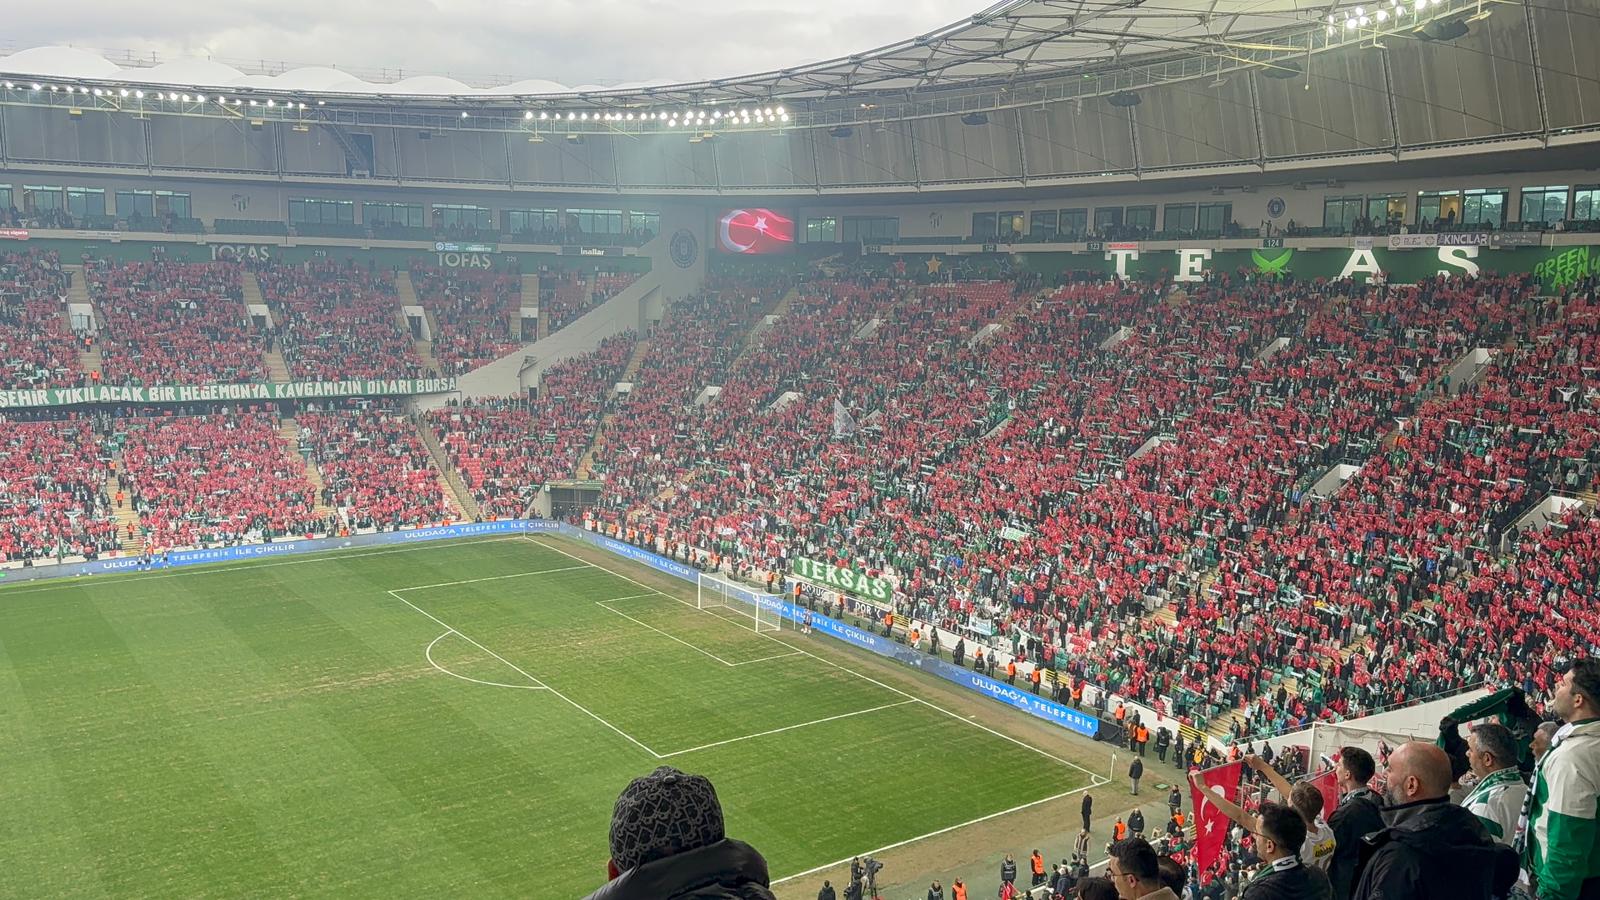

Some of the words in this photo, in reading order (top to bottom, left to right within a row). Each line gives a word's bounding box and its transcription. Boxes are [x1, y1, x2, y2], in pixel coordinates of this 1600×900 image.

[1267, 239, 1279, 247] 124
[436, 252, 492, 270] TOFAŞ
[55, 386, 144, 405] YIKILACAK
[149, 386, 176, 401] BİR
[180, 383, 271, 401] HEGEMONYA
[275, 380, 362, 399] KAVGAMIZIN
[367, 379, 412, 394] DİYARI
[416, 377, 456, 393] BURSA
[511, 521, 525, 529] İLE
[528, 521, 559, 530] ÇIKILIR
[236, 547, 252, 556] İLE
[255, 544, 295, 554] ÇIKILIR
[798, 556, 887, 599] TEKSAS
[832, 621, 844, 633] İLE
[845, 628, 876, 646] ÇIKILIR
[971, 677, 1028, 704] ULUDAĞ'A
[1033, 701, 1093, 729] TELEFERİK
